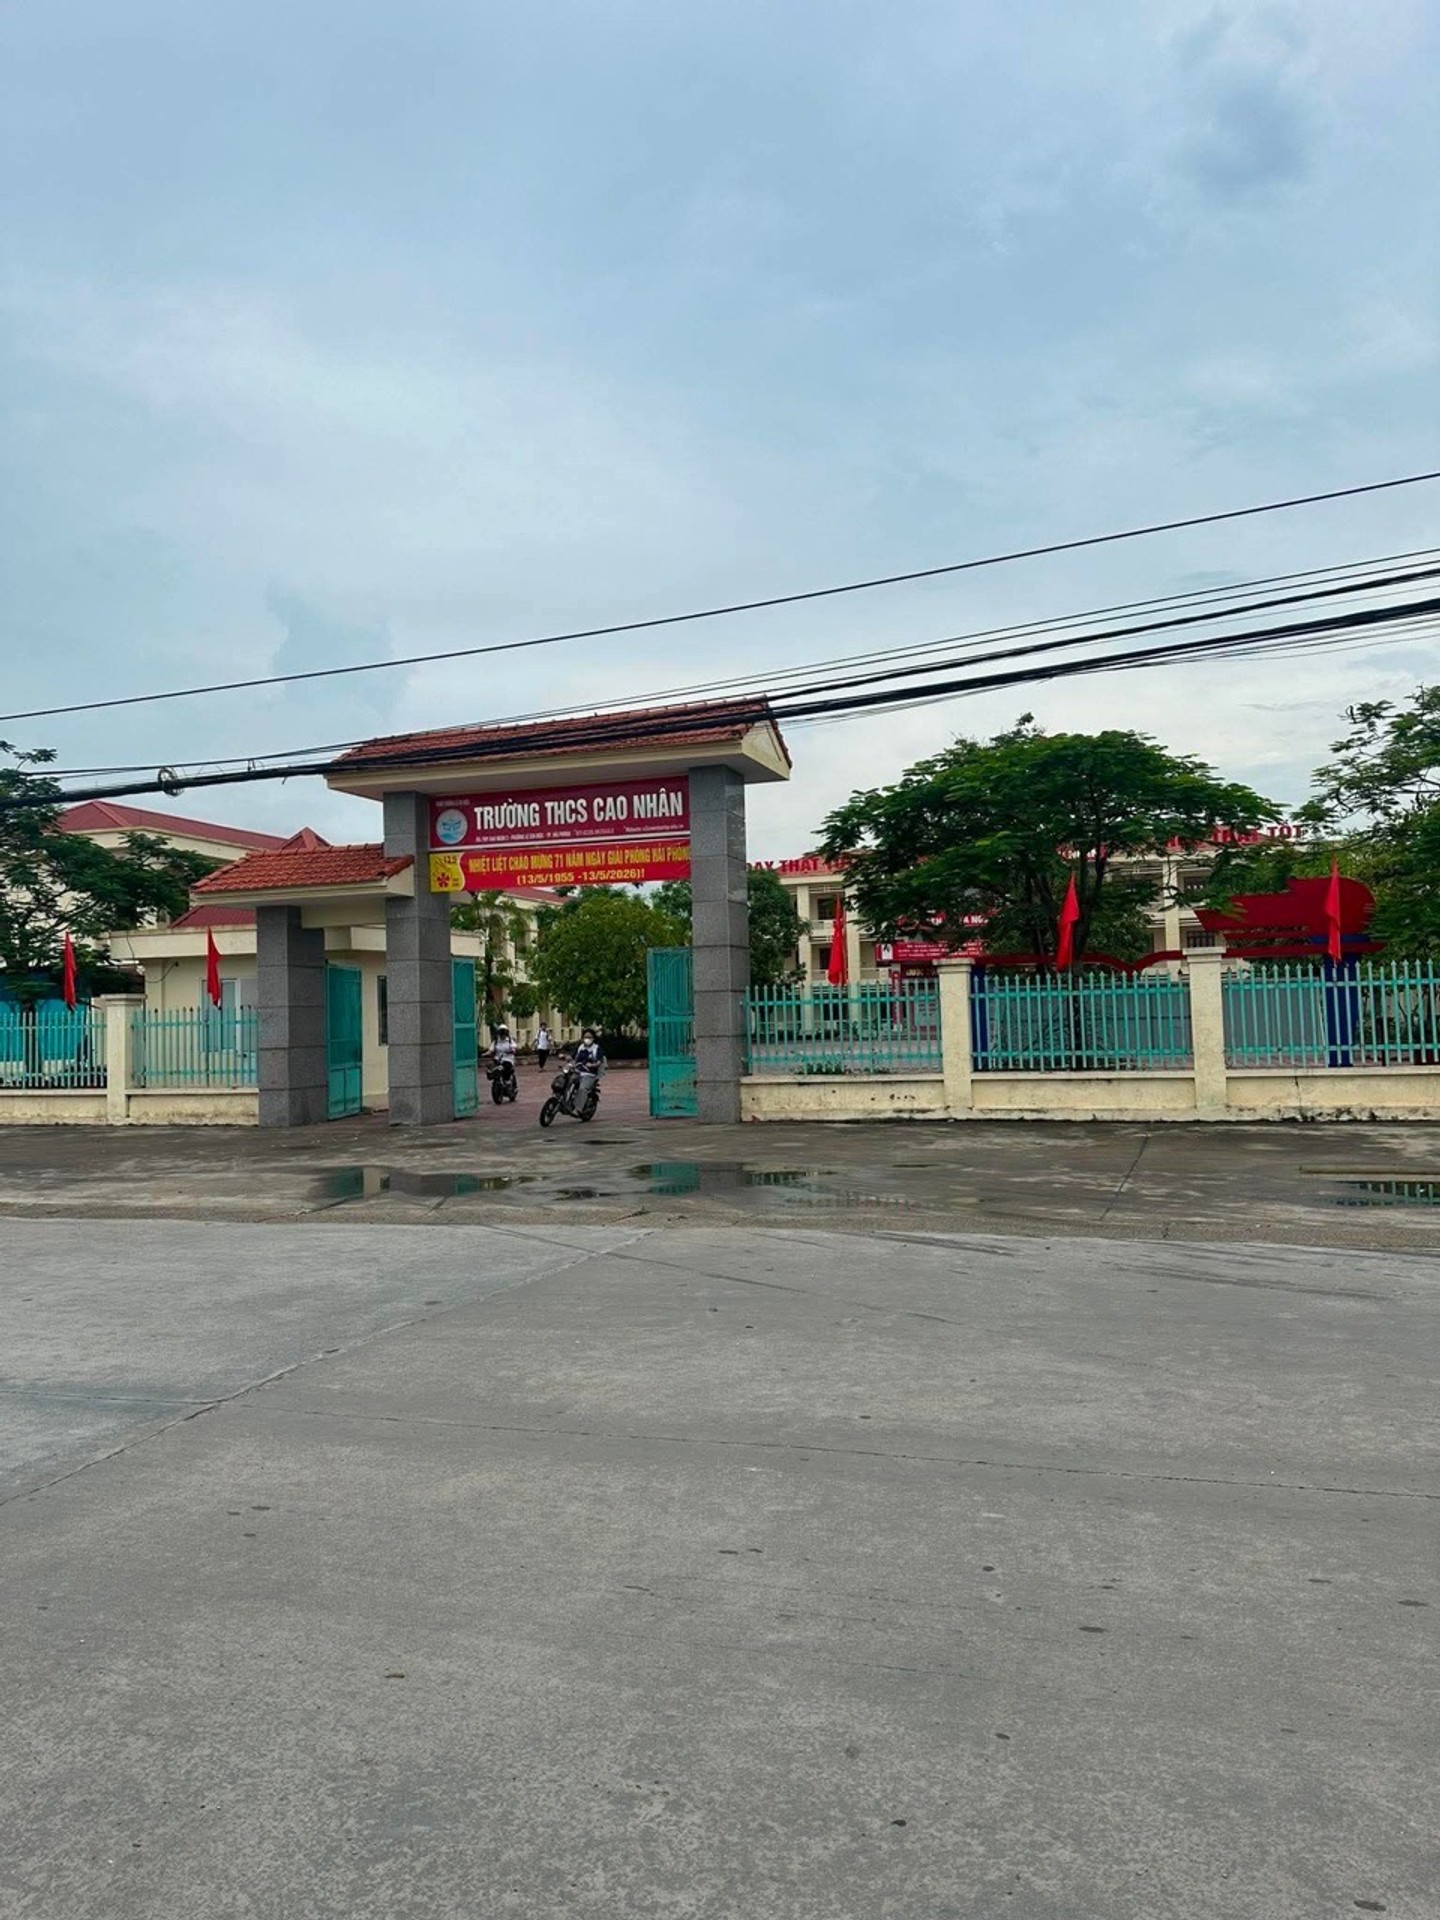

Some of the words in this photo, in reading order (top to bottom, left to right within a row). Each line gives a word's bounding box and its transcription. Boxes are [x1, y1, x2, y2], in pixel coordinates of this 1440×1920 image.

[474, 798, 540, 830] TRƯỜNG
[544, 799, 588, 825] THCS
[593, 795, 628, 822] CAO
[633, 788, 683, 819] NHÂN
[554, 853, 563, 868] 71
